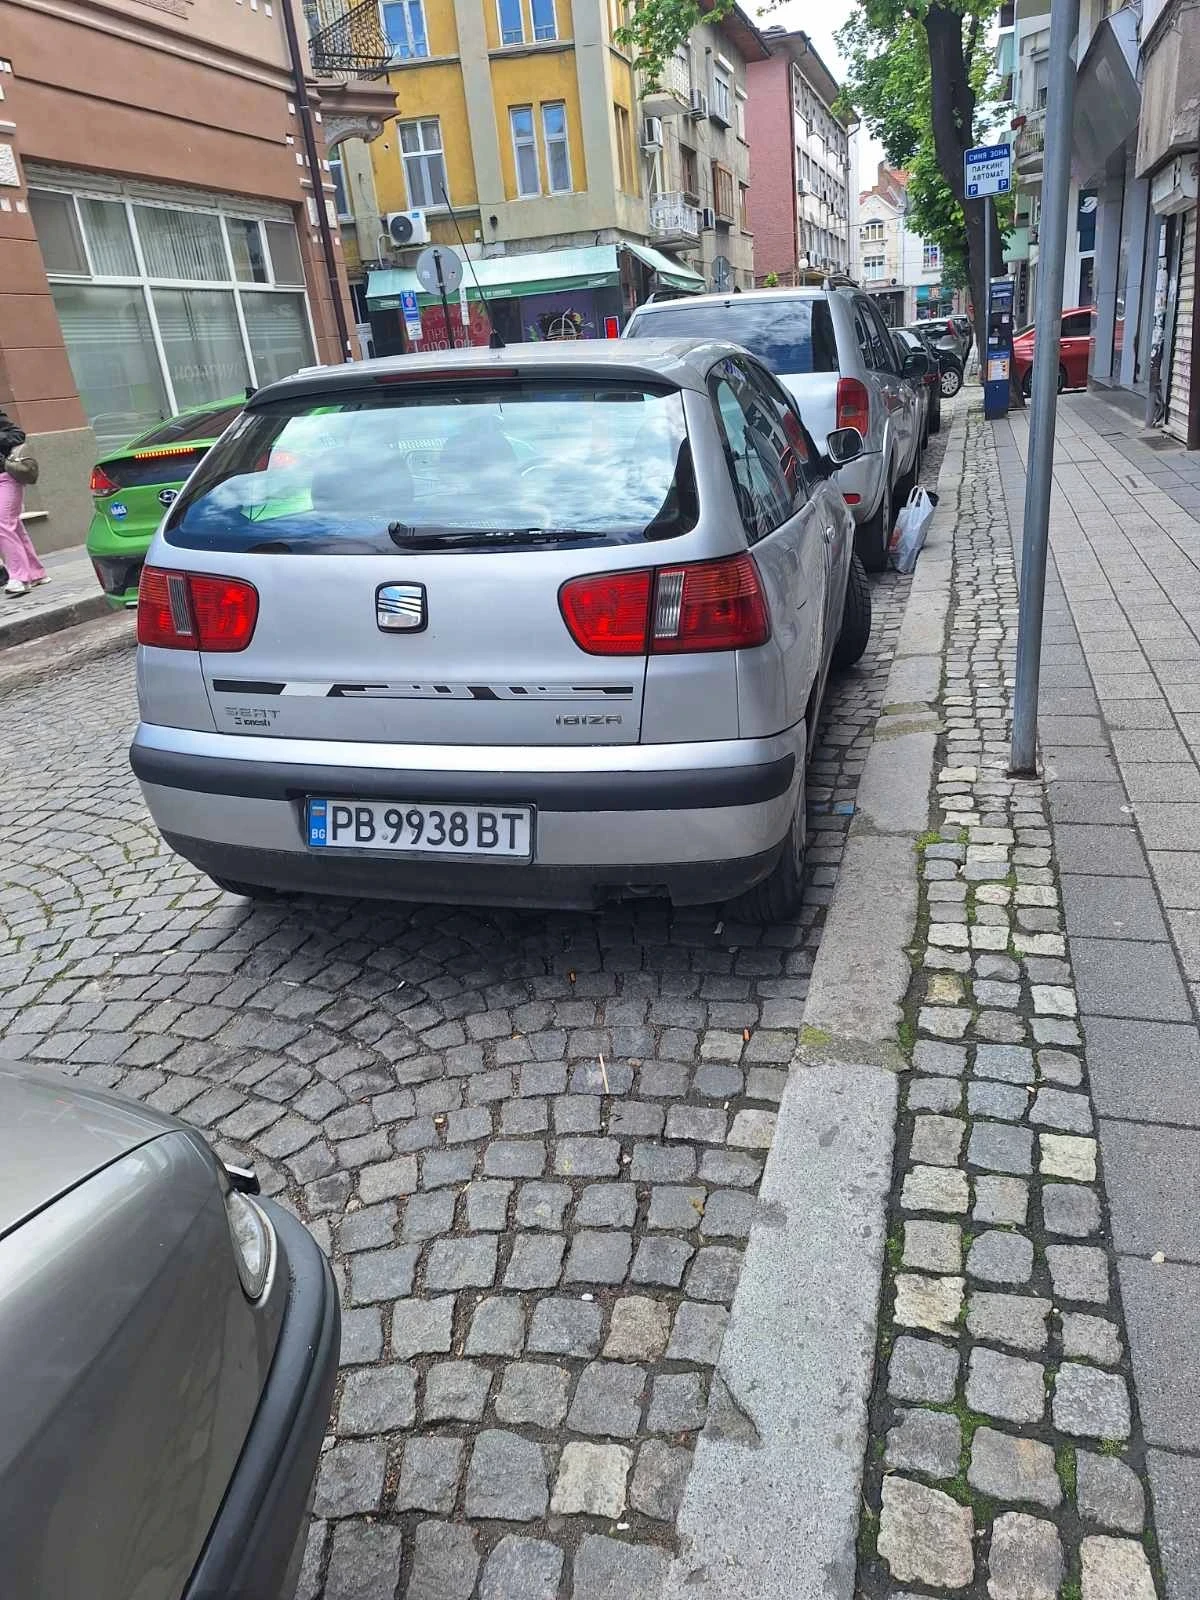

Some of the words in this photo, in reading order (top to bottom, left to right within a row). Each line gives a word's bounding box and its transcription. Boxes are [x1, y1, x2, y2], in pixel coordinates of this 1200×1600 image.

[968, 152, 987, 162] СИНЯ
[990, 148, 1008, 158] ЗОНА
[972, 161, 1004, 173] ПАРКИНГ
[972, 169, 1004, 181] АВТОМАТ
[224, 706, 281, 719] SEAT
[555, 714, 623, 725] IBIZA
[311, 828, 326, 840] BG
[331, 806, 376, 842] PB
[383, 808, 469, 847] 9938
[477, 812, 524, 850] BT
